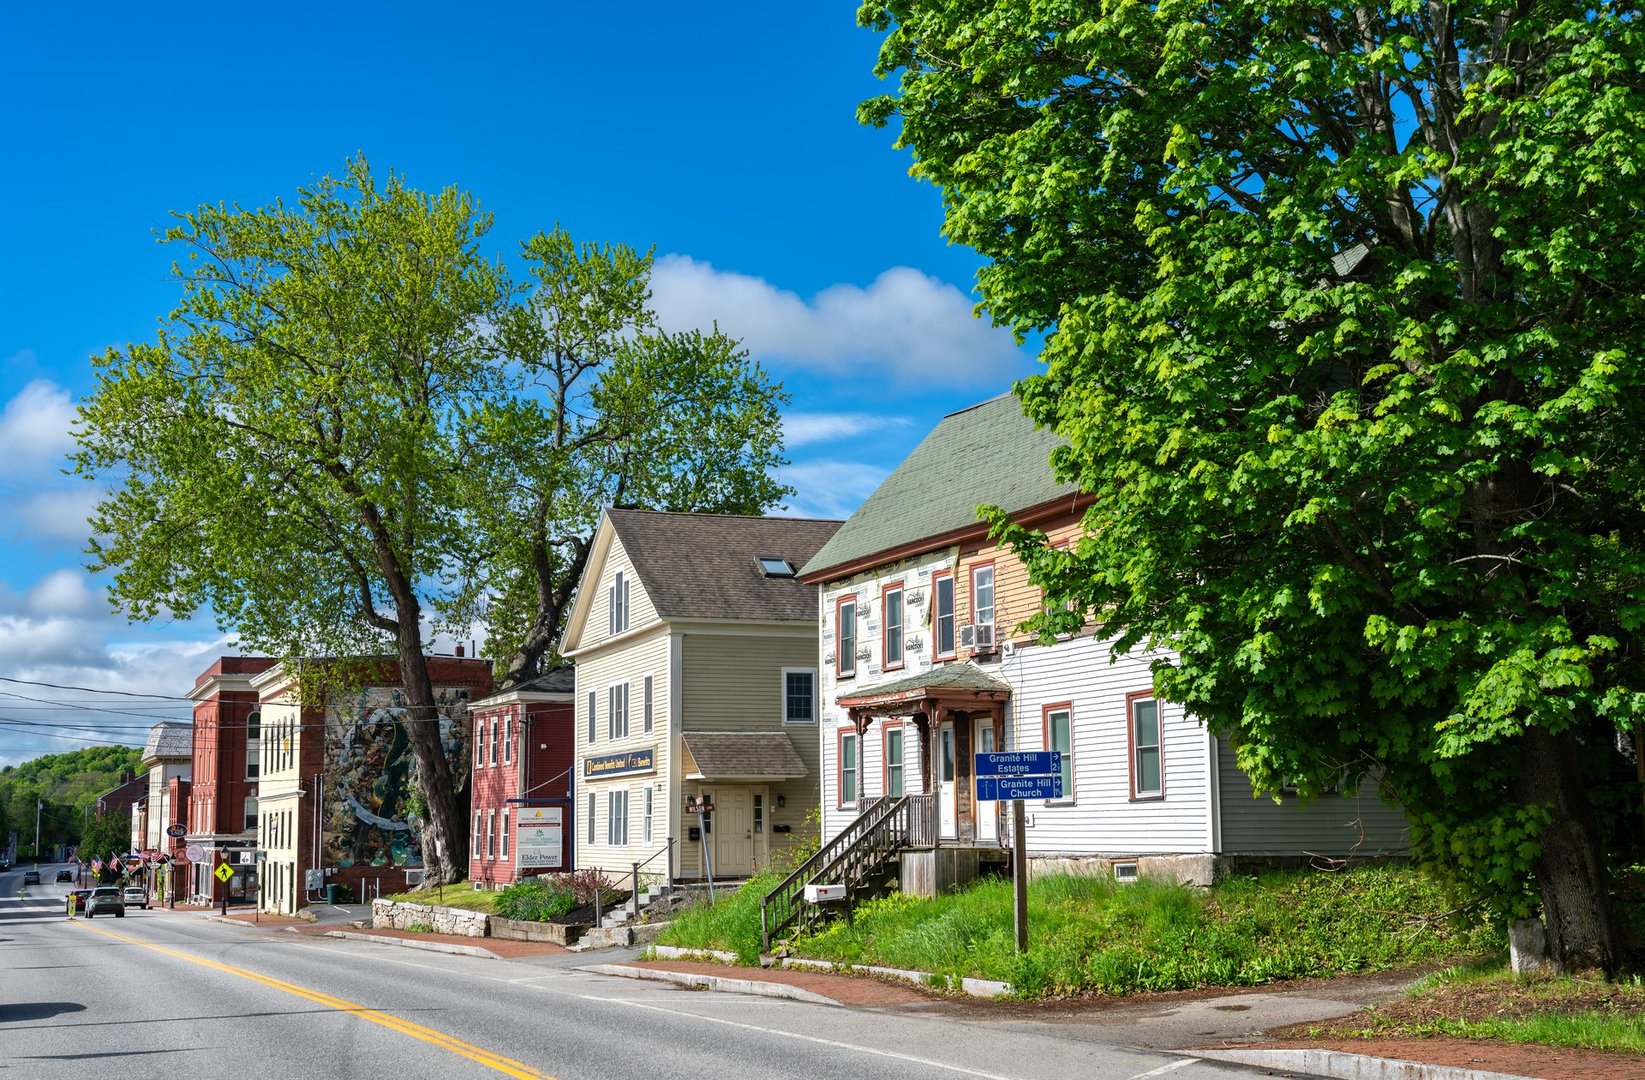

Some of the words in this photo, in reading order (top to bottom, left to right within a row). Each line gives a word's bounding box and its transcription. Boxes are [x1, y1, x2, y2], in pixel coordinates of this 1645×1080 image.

[989, 754, 1020, 763] Granite
[1023, 753, 1037, 761] Hill
[998, 764, 1030, 773] Estates
[1001, 780, 1033, 788] Granite
[1037, 779, 1051, 787] Hill
[1010, 789, 1042, 797] Church
